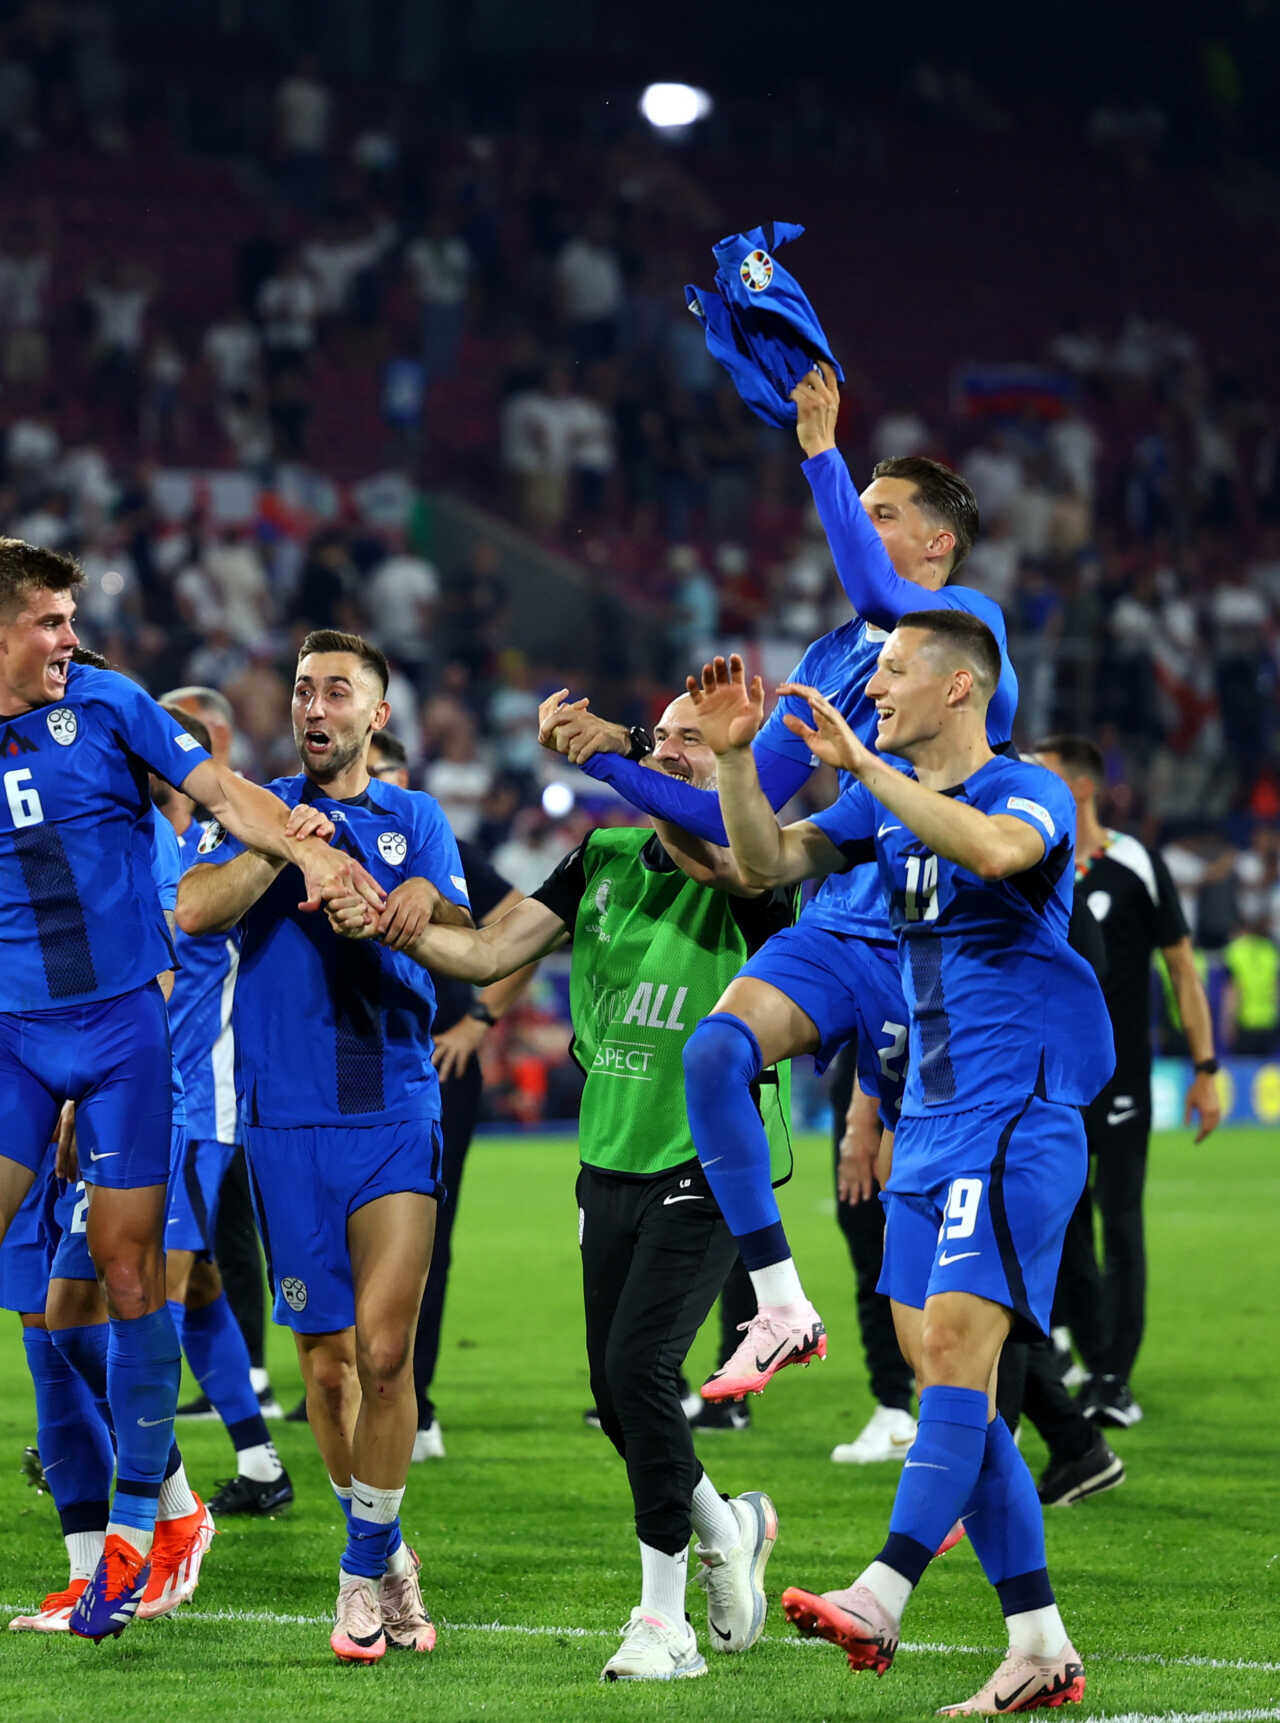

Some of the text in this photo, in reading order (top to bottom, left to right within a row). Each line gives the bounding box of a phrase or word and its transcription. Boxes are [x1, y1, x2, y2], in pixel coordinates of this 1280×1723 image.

[4, 768, 44, 829] 6
[905, 854, 939, 921] 19
[593, 1047, 654, 1072] SPECT
[877, 1020, 910, 1083] 2
